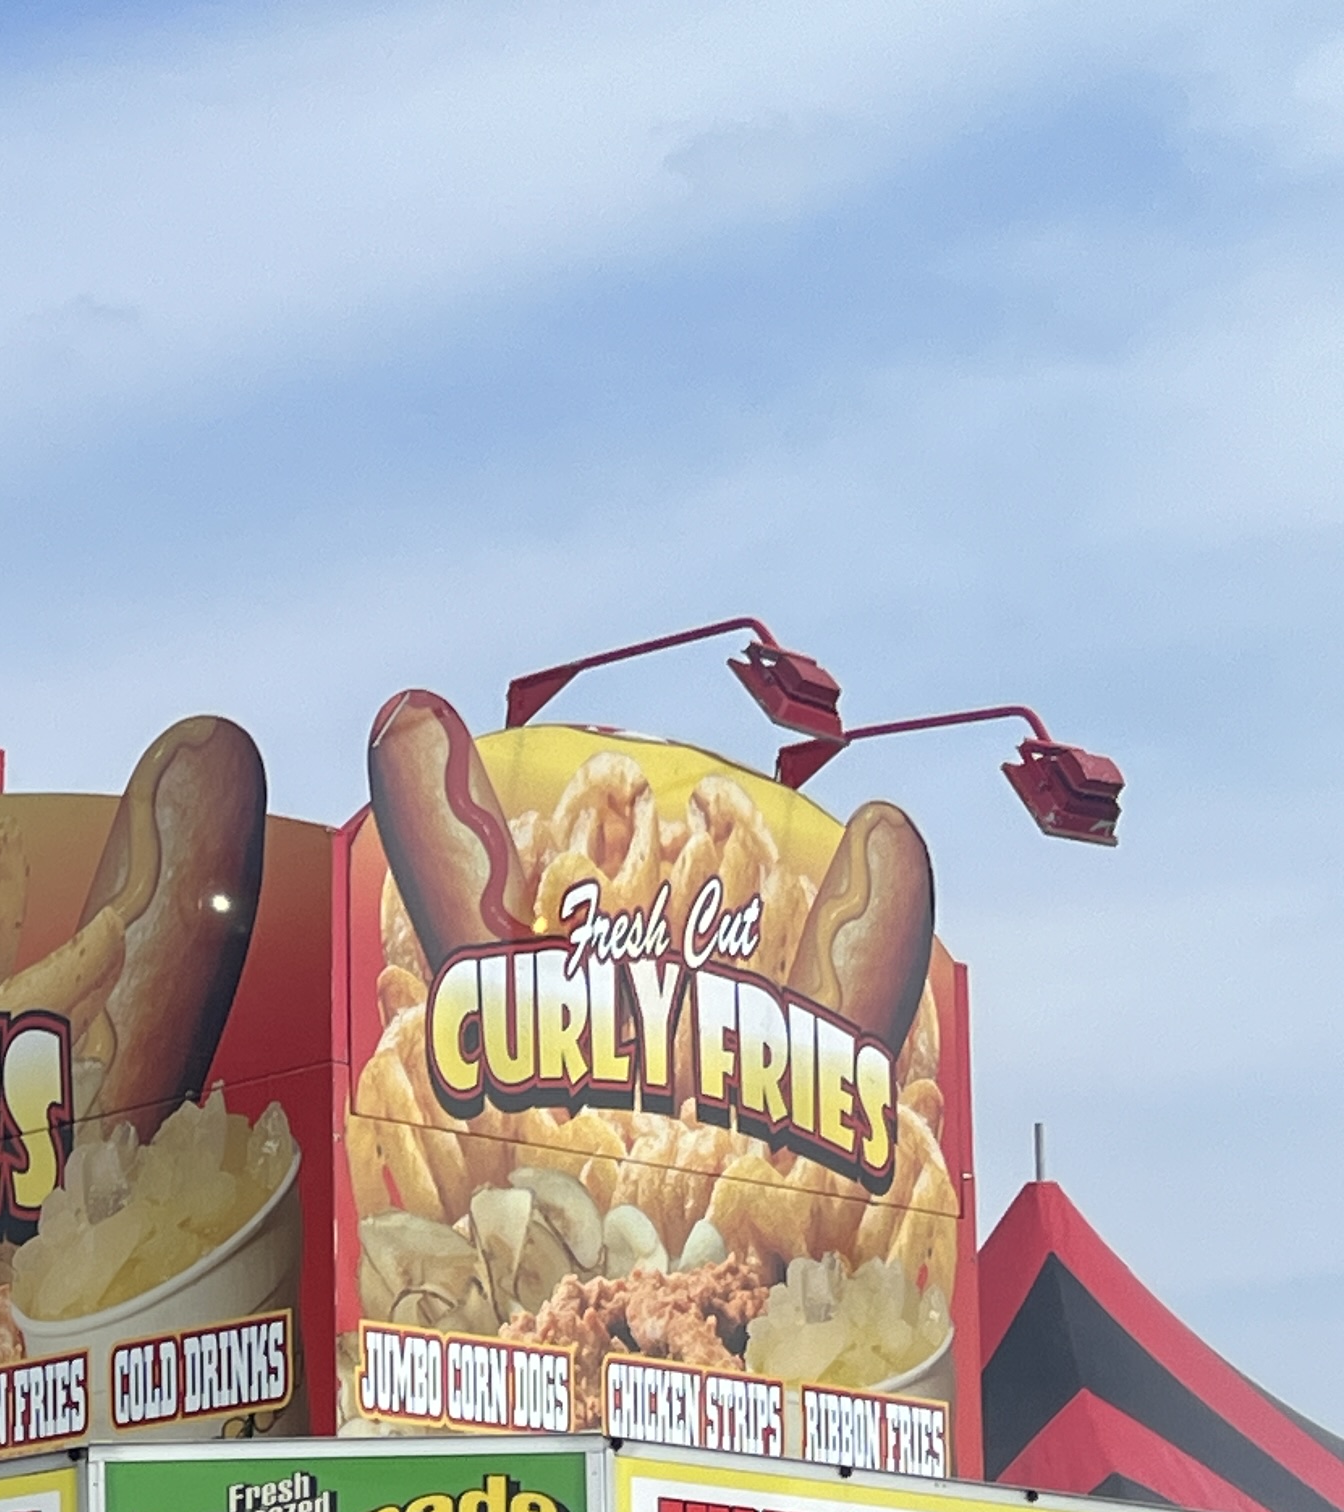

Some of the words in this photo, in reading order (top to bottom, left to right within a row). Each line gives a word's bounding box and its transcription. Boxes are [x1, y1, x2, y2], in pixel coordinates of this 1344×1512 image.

[559, 879, 673, 975] Fresh
[682, 876, 763, 969] Cut
[431, 948, 678, 1091] CURLY
[694, 970, 893, 1170] FRIES
[12, 1357, 87, 1441] FRIES
[113, 1337, 177, 1424] COLD
[183, 1320, 286, 1414] DRINKS
[361, 1330, 442, 1419] JUMBO
[445, 1337, 508, 1423] CORN
[512, 1349, 569, 1432] DOGS
[606, 1362, 701, 1448] CHICKEN
[705, 1382, 783, 1458] STRIPS
[803, 1390, 880, 1470] RIBBON
[885, 1404, 946, 1478] FRIES
[229, 1471, 311, 1512] Fresh
